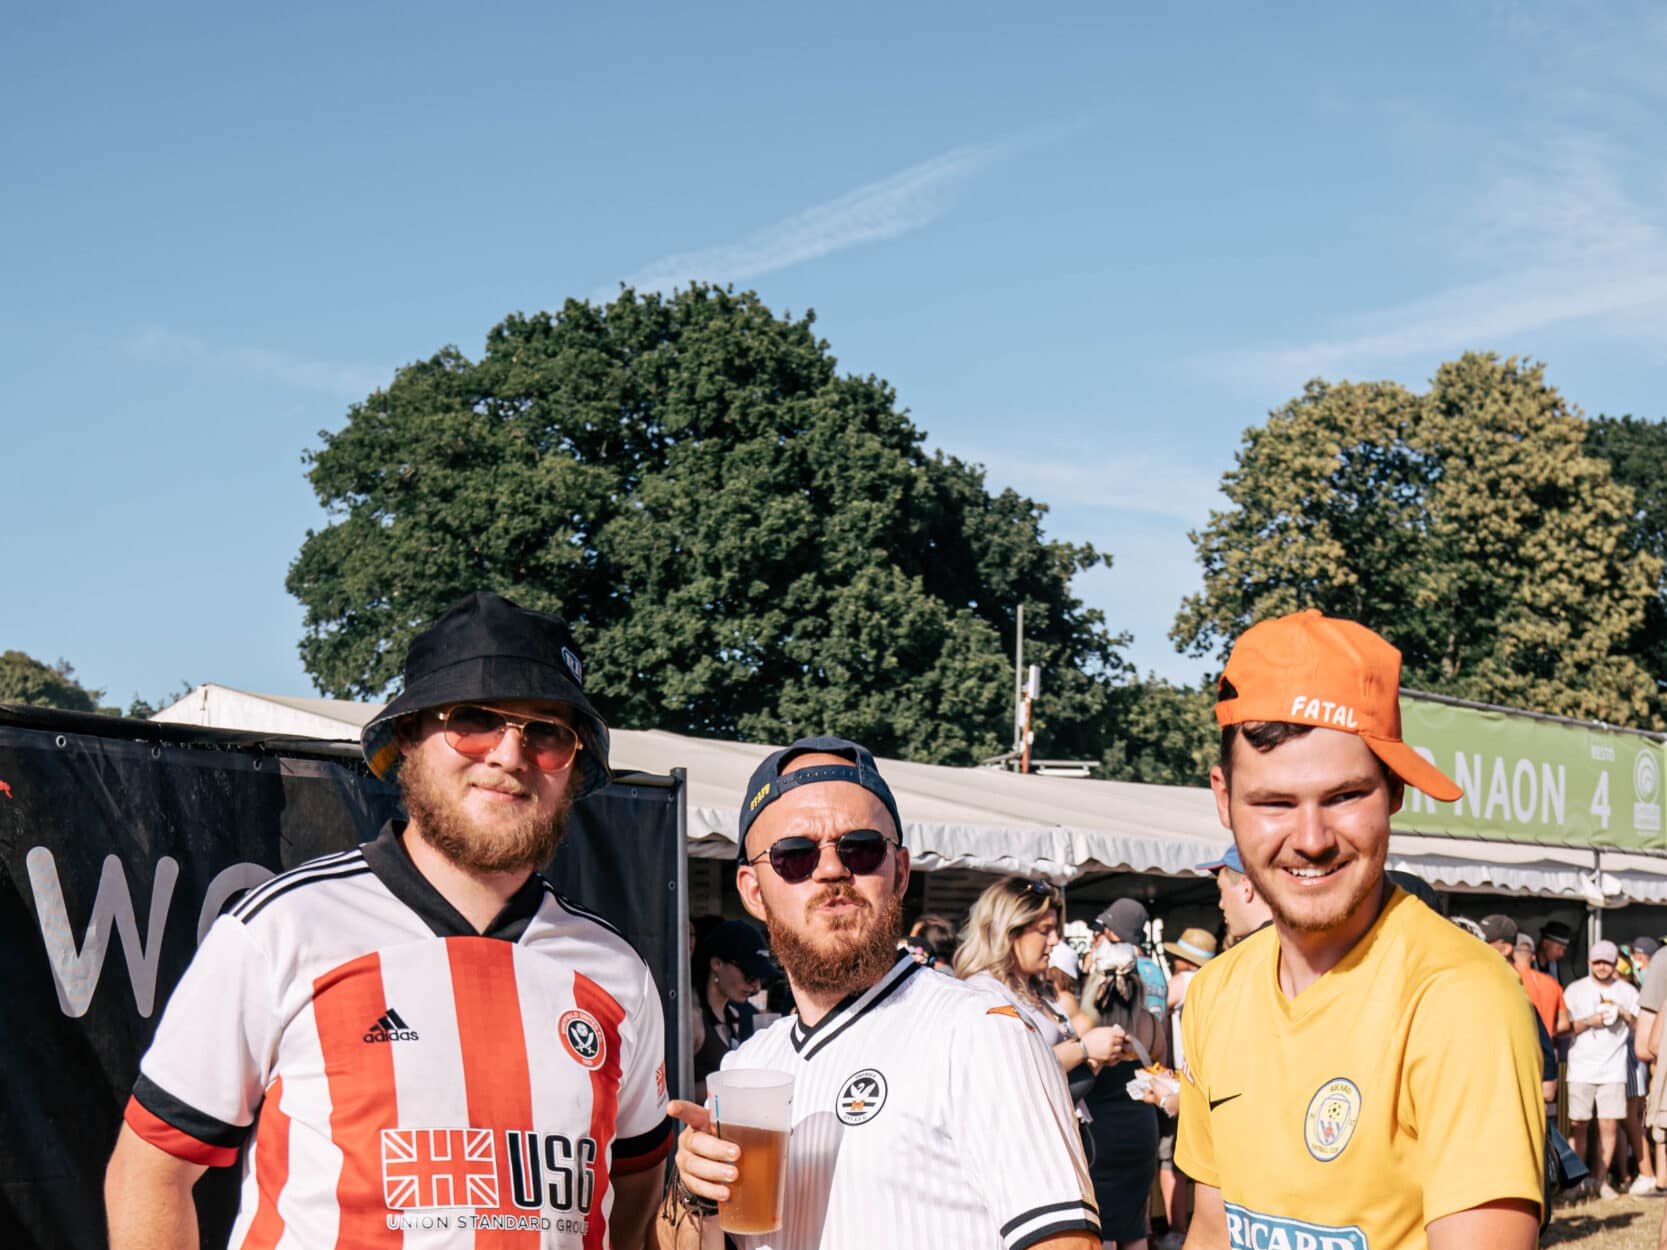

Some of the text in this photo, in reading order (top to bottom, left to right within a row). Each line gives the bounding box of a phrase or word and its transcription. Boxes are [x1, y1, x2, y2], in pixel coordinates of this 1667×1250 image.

[1290, 695, 1359, 729] FATAL
[1453, 750, 1566, 826] NAON
[1591, 769, 1612, 830] 4
[363, 1029, 419, 1044] adidas
[506, 1130, 597, 1214] USG
[386, 1213, 449, 1231] UNION
[457, 1214, 551, 1231] STANDARD
